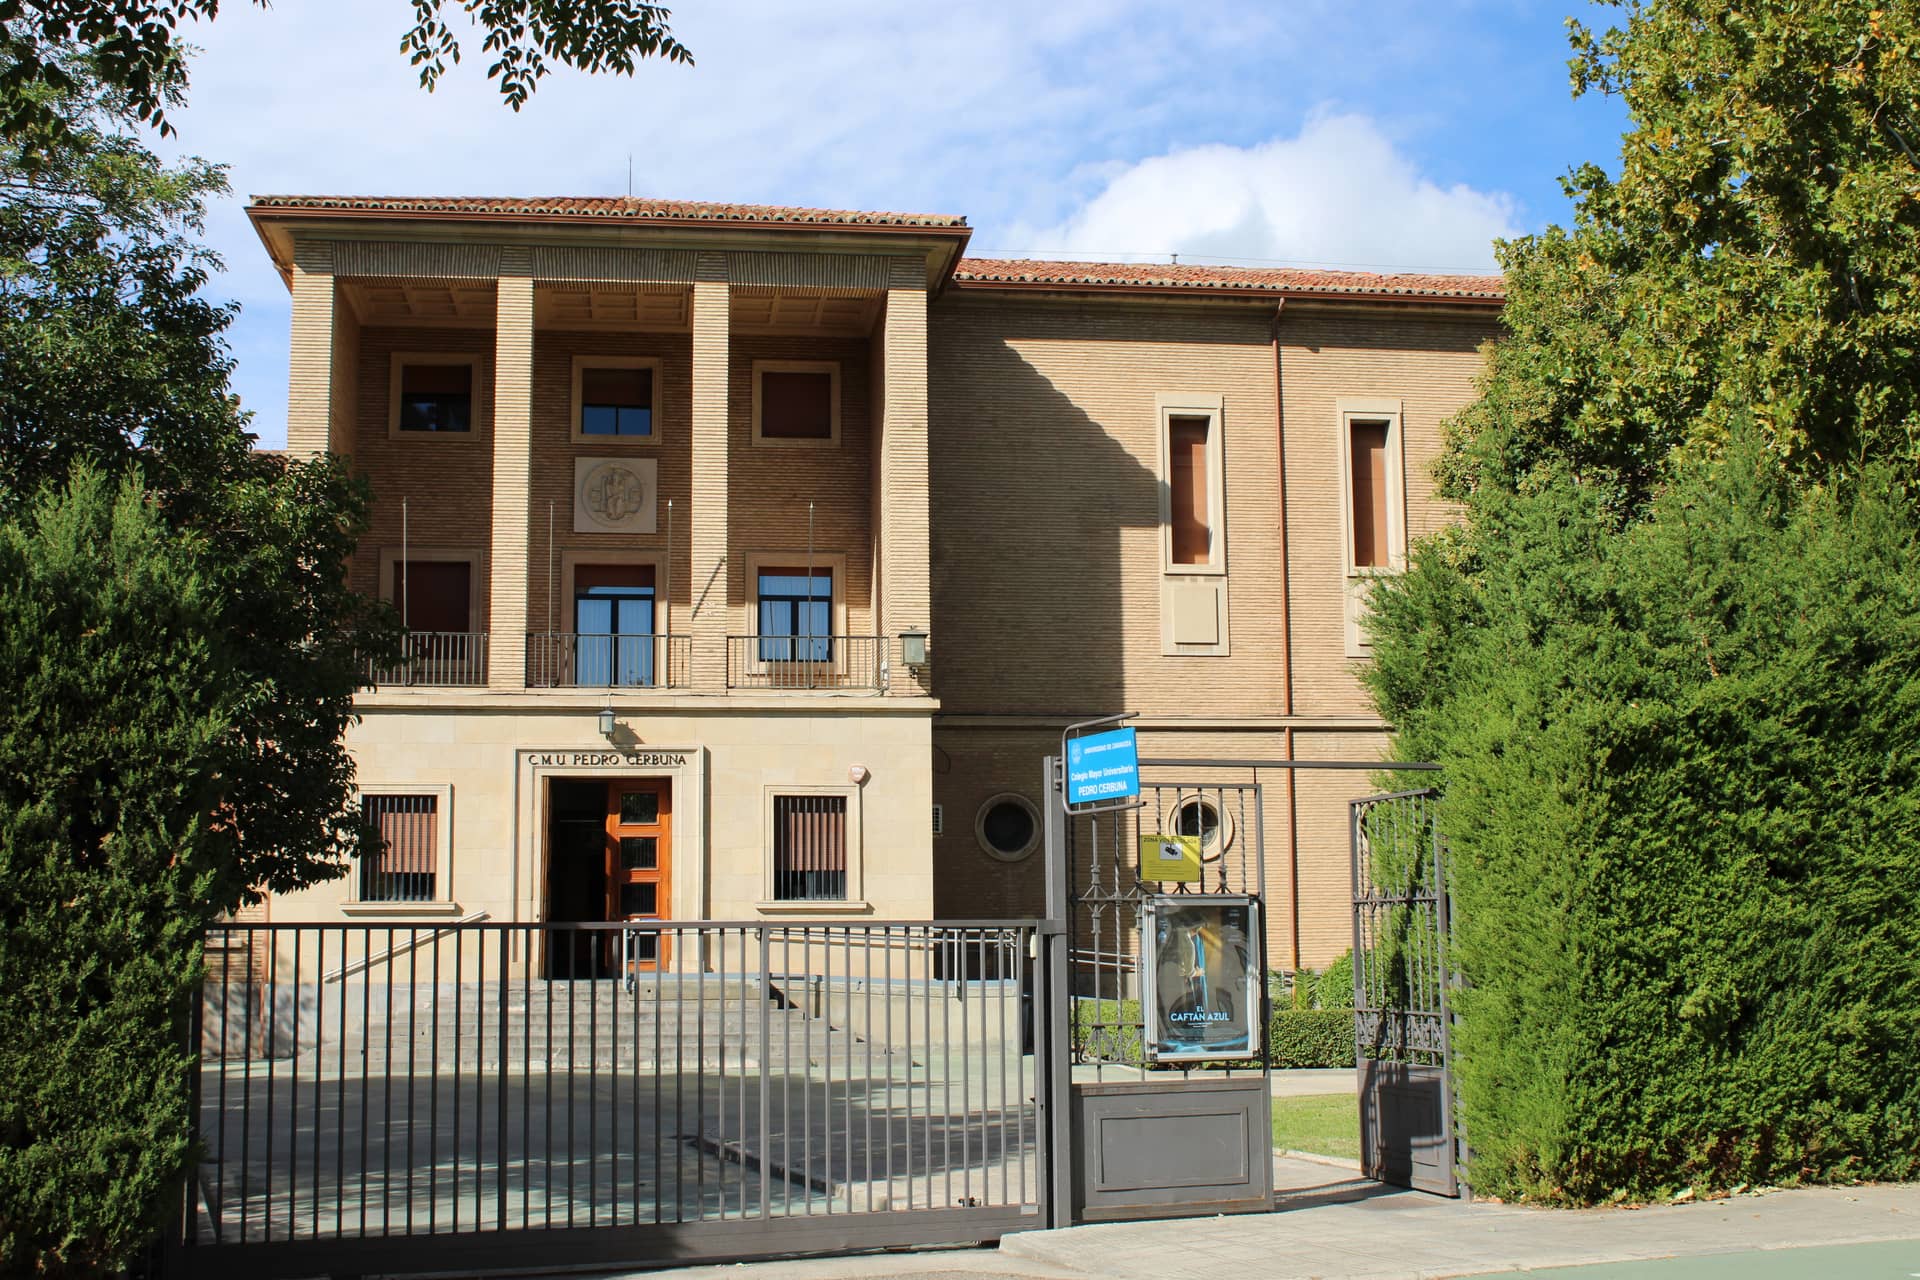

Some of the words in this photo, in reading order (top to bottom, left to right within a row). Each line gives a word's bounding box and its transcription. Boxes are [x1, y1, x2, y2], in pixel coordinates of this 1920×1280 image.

[573, 754, 620, 765] PEDRO
[626, 754, 687, 765] CERBUNA
[1071, 772, 1088, 782] Colegio
[1088, 770, 1102, 779] Mayor
[1103, 765, 1134, 776] Universitario
[1078, 785, 1097, 796] PEDRO
[1098, 780, 1128, 794] CERBUNA
[1207, 1012, 1230, 1021] AZUL
